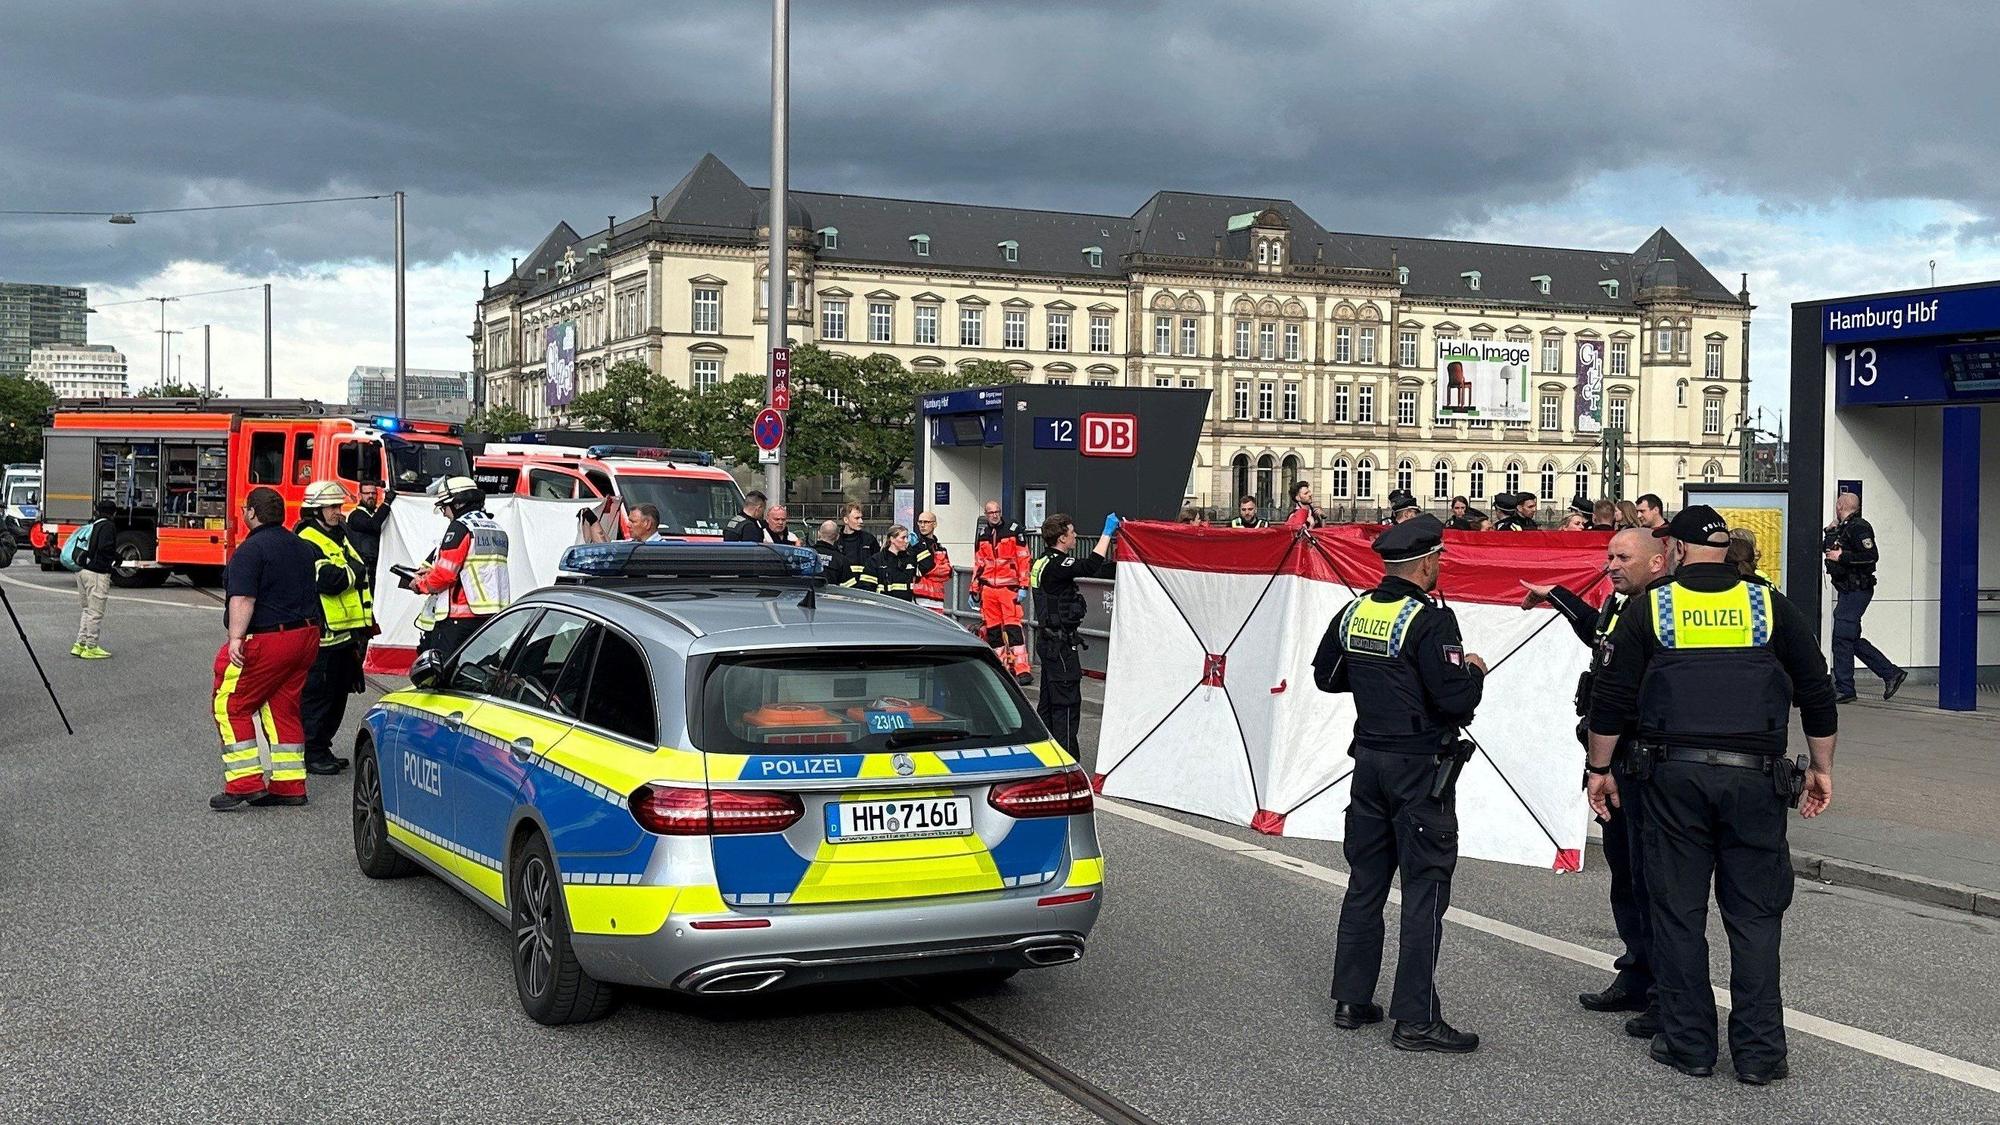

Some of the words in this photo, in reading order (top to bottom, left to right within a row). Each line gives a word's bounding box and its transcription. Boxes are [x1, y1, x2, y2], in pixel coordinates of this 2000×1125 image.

[1830, 307, 1902, 330] Hamburg
[1907, 300, 1938, 323] Hbf
[776, 352, 786, 360] 01
[1440, 341, 1478, 359] Hello
[1482, 343, 1530, 366] Image
[775, 369, 786, 377] 07
[1844, 347, 1878, 387] 13
[1050, 420, 1073, 442] 12
[1089, 421, 1130, 450] DB
[445, 457, 451, 467] 6
[1702, 522, 1727, 533] POLIZ
[1682, 609, 1743, 626] POLIZEI
[1351, 617, 1391, 637] POLIZEI
[875, 714, 904, 730] 23/10
[404, 750, 442, 797] POLIZEI
[762, 759, 842, 776] POLIZEI
[852, 805, 884, 832] HH
[900, 802, 958, 828] 7160
[831, 824, 837, 832] D
